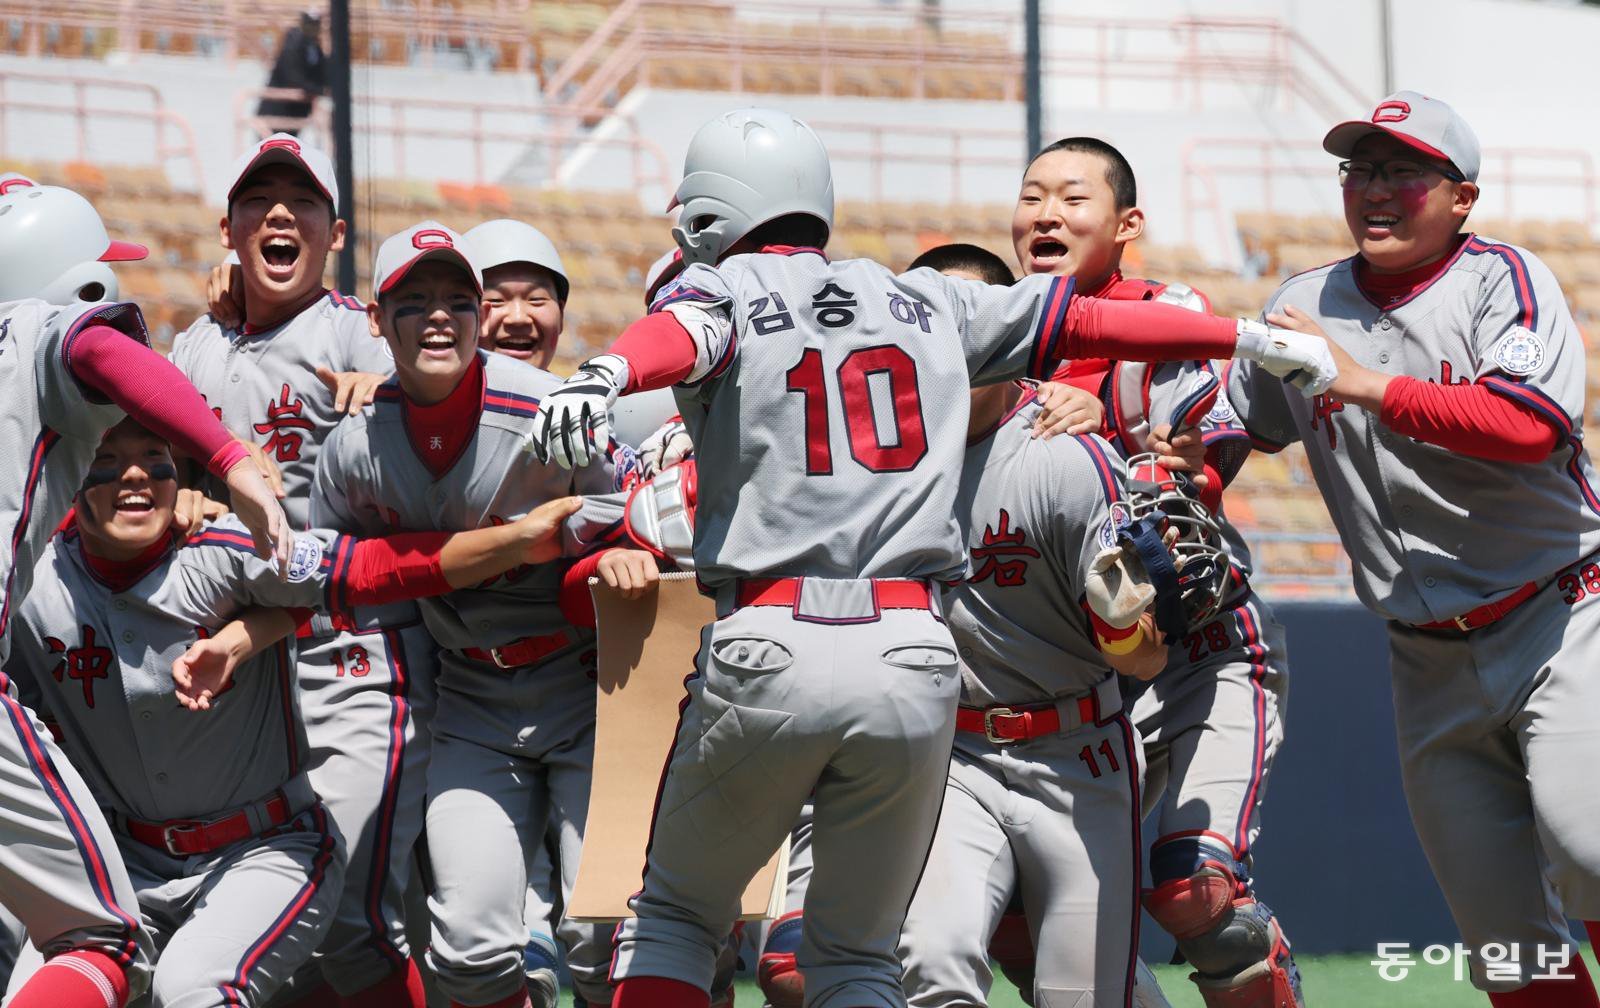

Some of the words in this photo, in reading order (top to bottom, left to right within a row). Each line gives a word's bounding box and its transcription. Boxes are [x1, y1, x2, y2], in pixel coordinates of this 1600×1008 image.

[1372, 101, 1411, 123] C
[412, 230, 454, 250] C
[748, 283, 932, 336] 김승하
[786, 343, 928, 476] 10
[966, 507, 1041, 587] 岩
[1557, 563, 1600, 605] 38
[329, 645, 371, 677] 13
[1183, 620, 1231, 663] 28
[1079, 739, 1121, 779] 11
